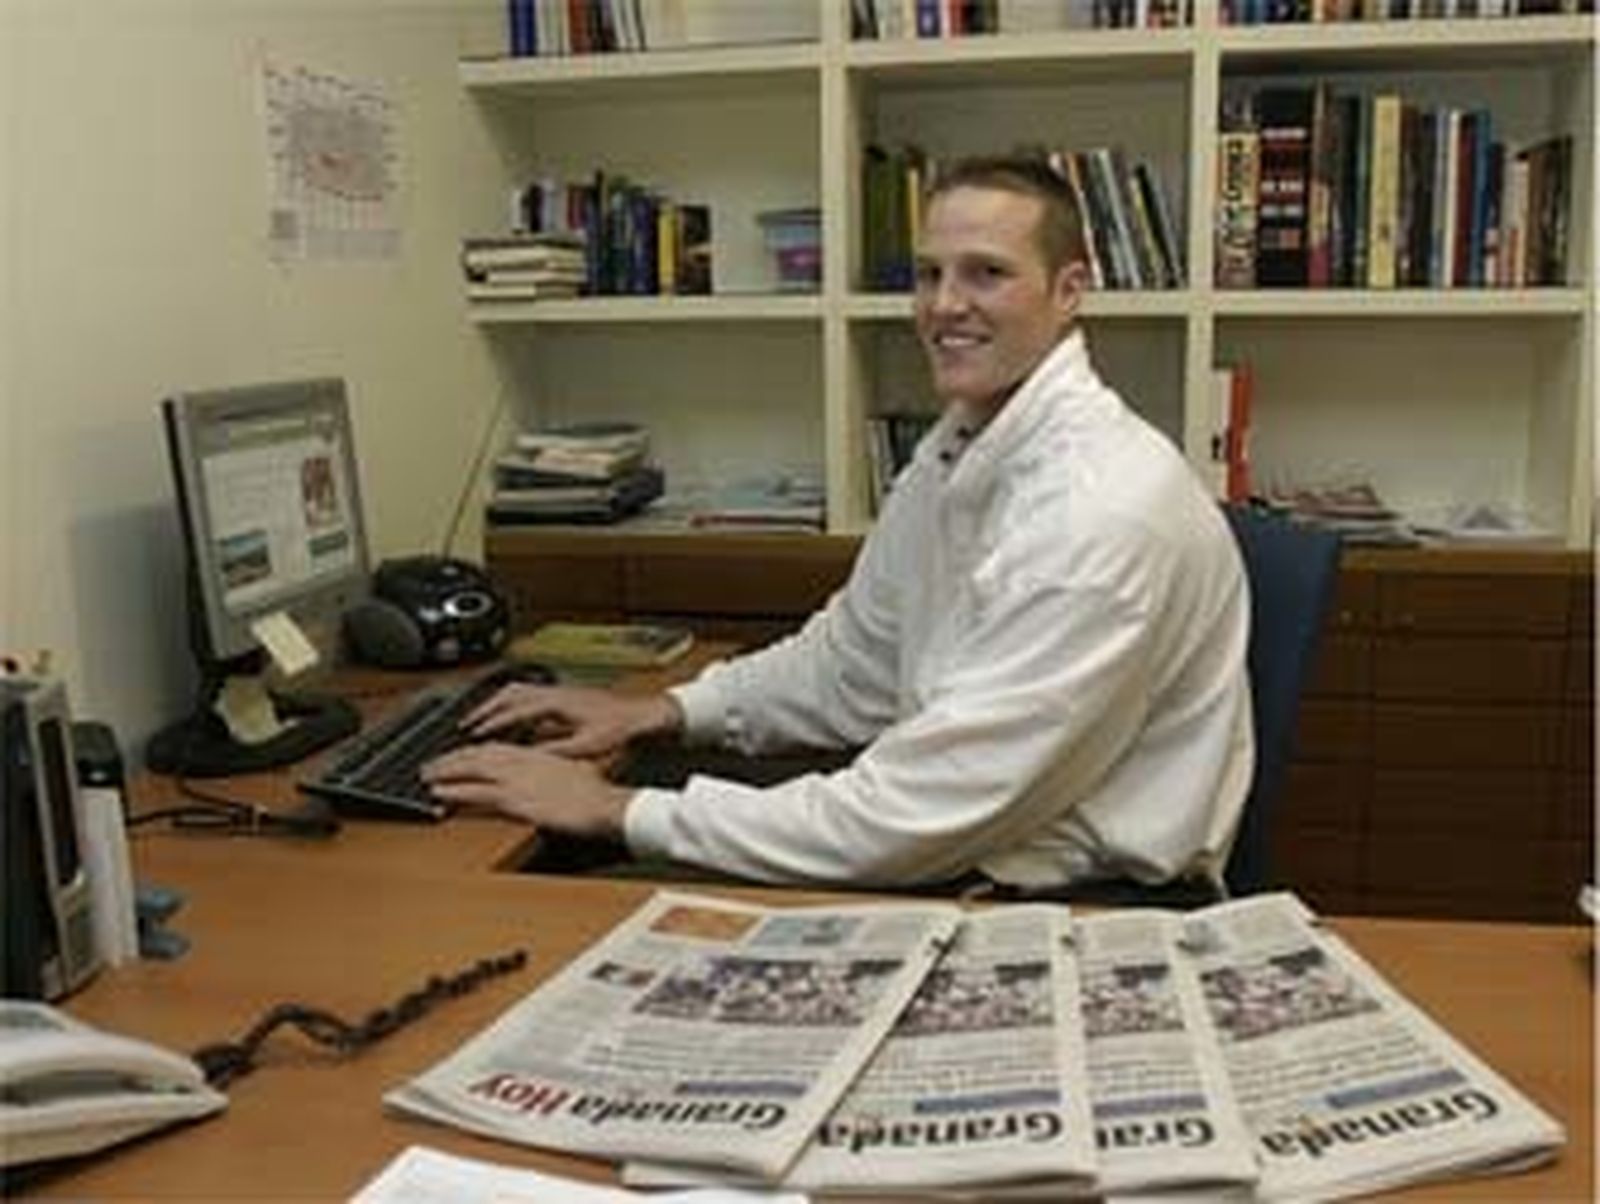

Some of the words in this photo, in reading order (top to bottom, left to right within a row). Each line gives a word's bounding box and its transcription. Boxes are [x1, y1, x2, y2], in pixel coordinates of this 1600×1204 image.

[469, 1075, 569, 1115] Hoy
[573, 1096, 786, 1129] Granada
[817, 1113, 1061, 1152] Granada
[1260, 1091, 1498, 1157] Granada
